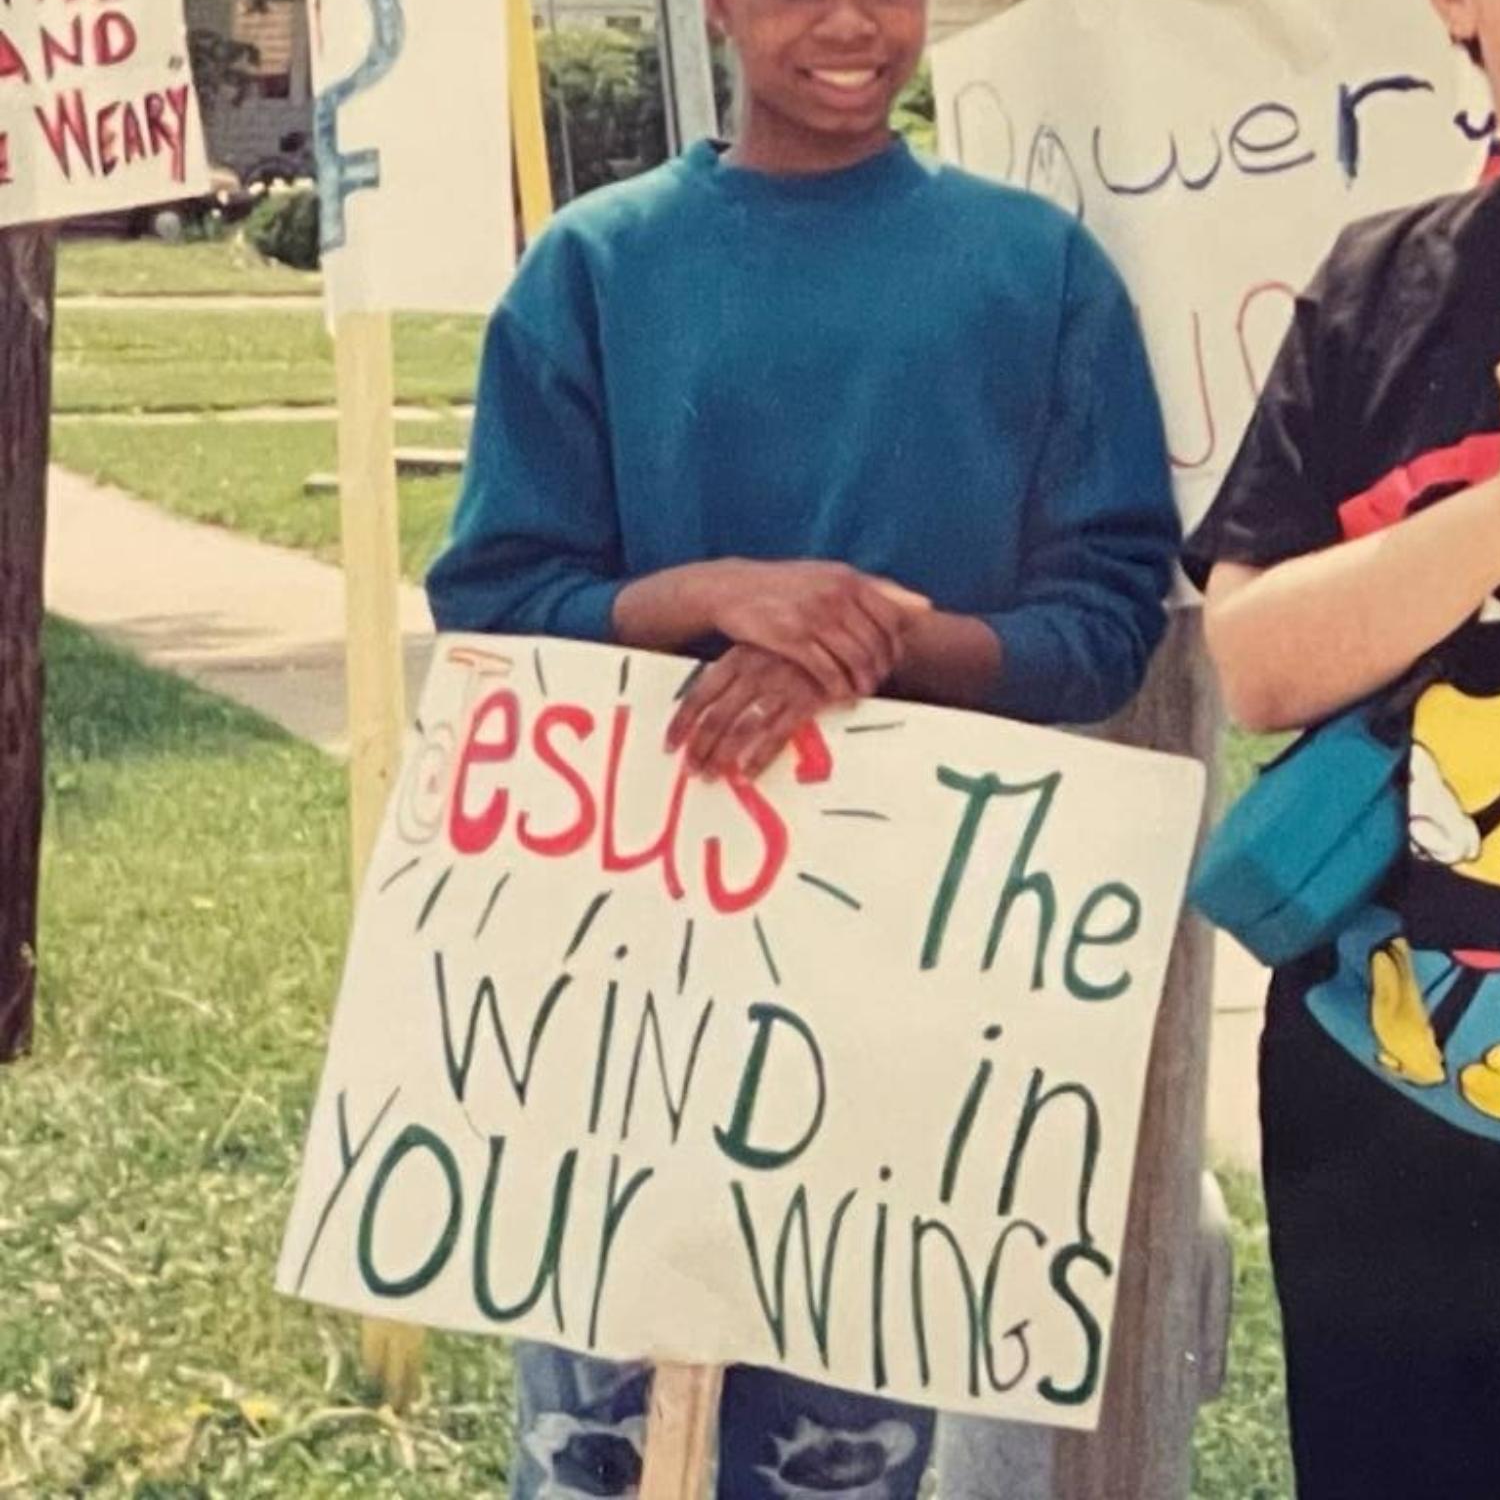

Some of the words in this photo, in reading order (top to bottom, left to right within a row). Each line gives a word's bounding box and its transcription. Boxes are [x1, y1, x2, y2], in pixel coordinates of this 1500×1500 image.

[35, 84, 189, 184] WEARY
[920, 763, 1142, 1002] The
[940, 1024, 1114, 1250] in
